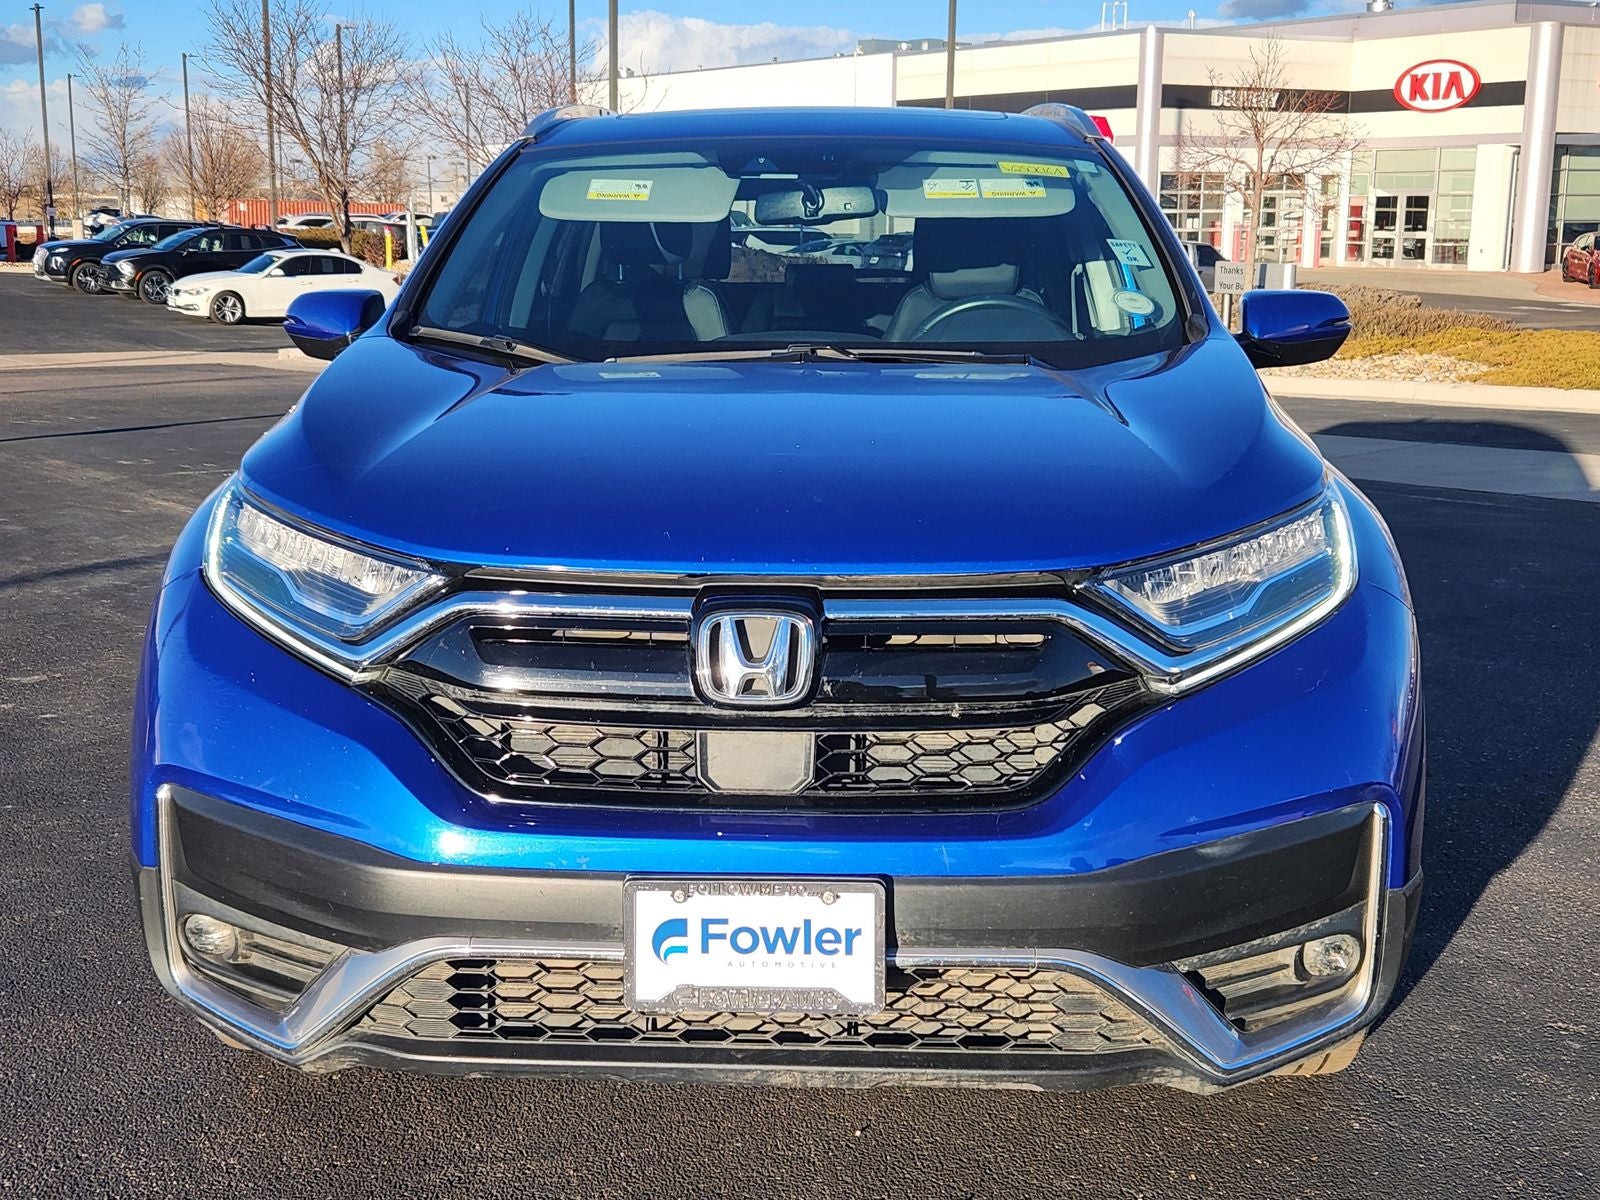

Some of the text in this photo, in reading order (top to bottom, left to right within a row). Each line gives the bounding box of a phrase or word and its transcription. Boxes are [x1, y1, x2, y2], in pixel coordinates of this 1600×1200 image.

[1409, 71, 1465, 101] KIA
[1110, 241, 1137, 249] SAFETY
[1127, 255, 1140, 263] OK
[1220, 265, 1243, 275] Thanks
[1219, 281, 1234, 290] Your
[687, 883, 756, 896] FOLLOW
[758, 884, 784, 897] ME
[701, 918, 862, 956] Fowler
